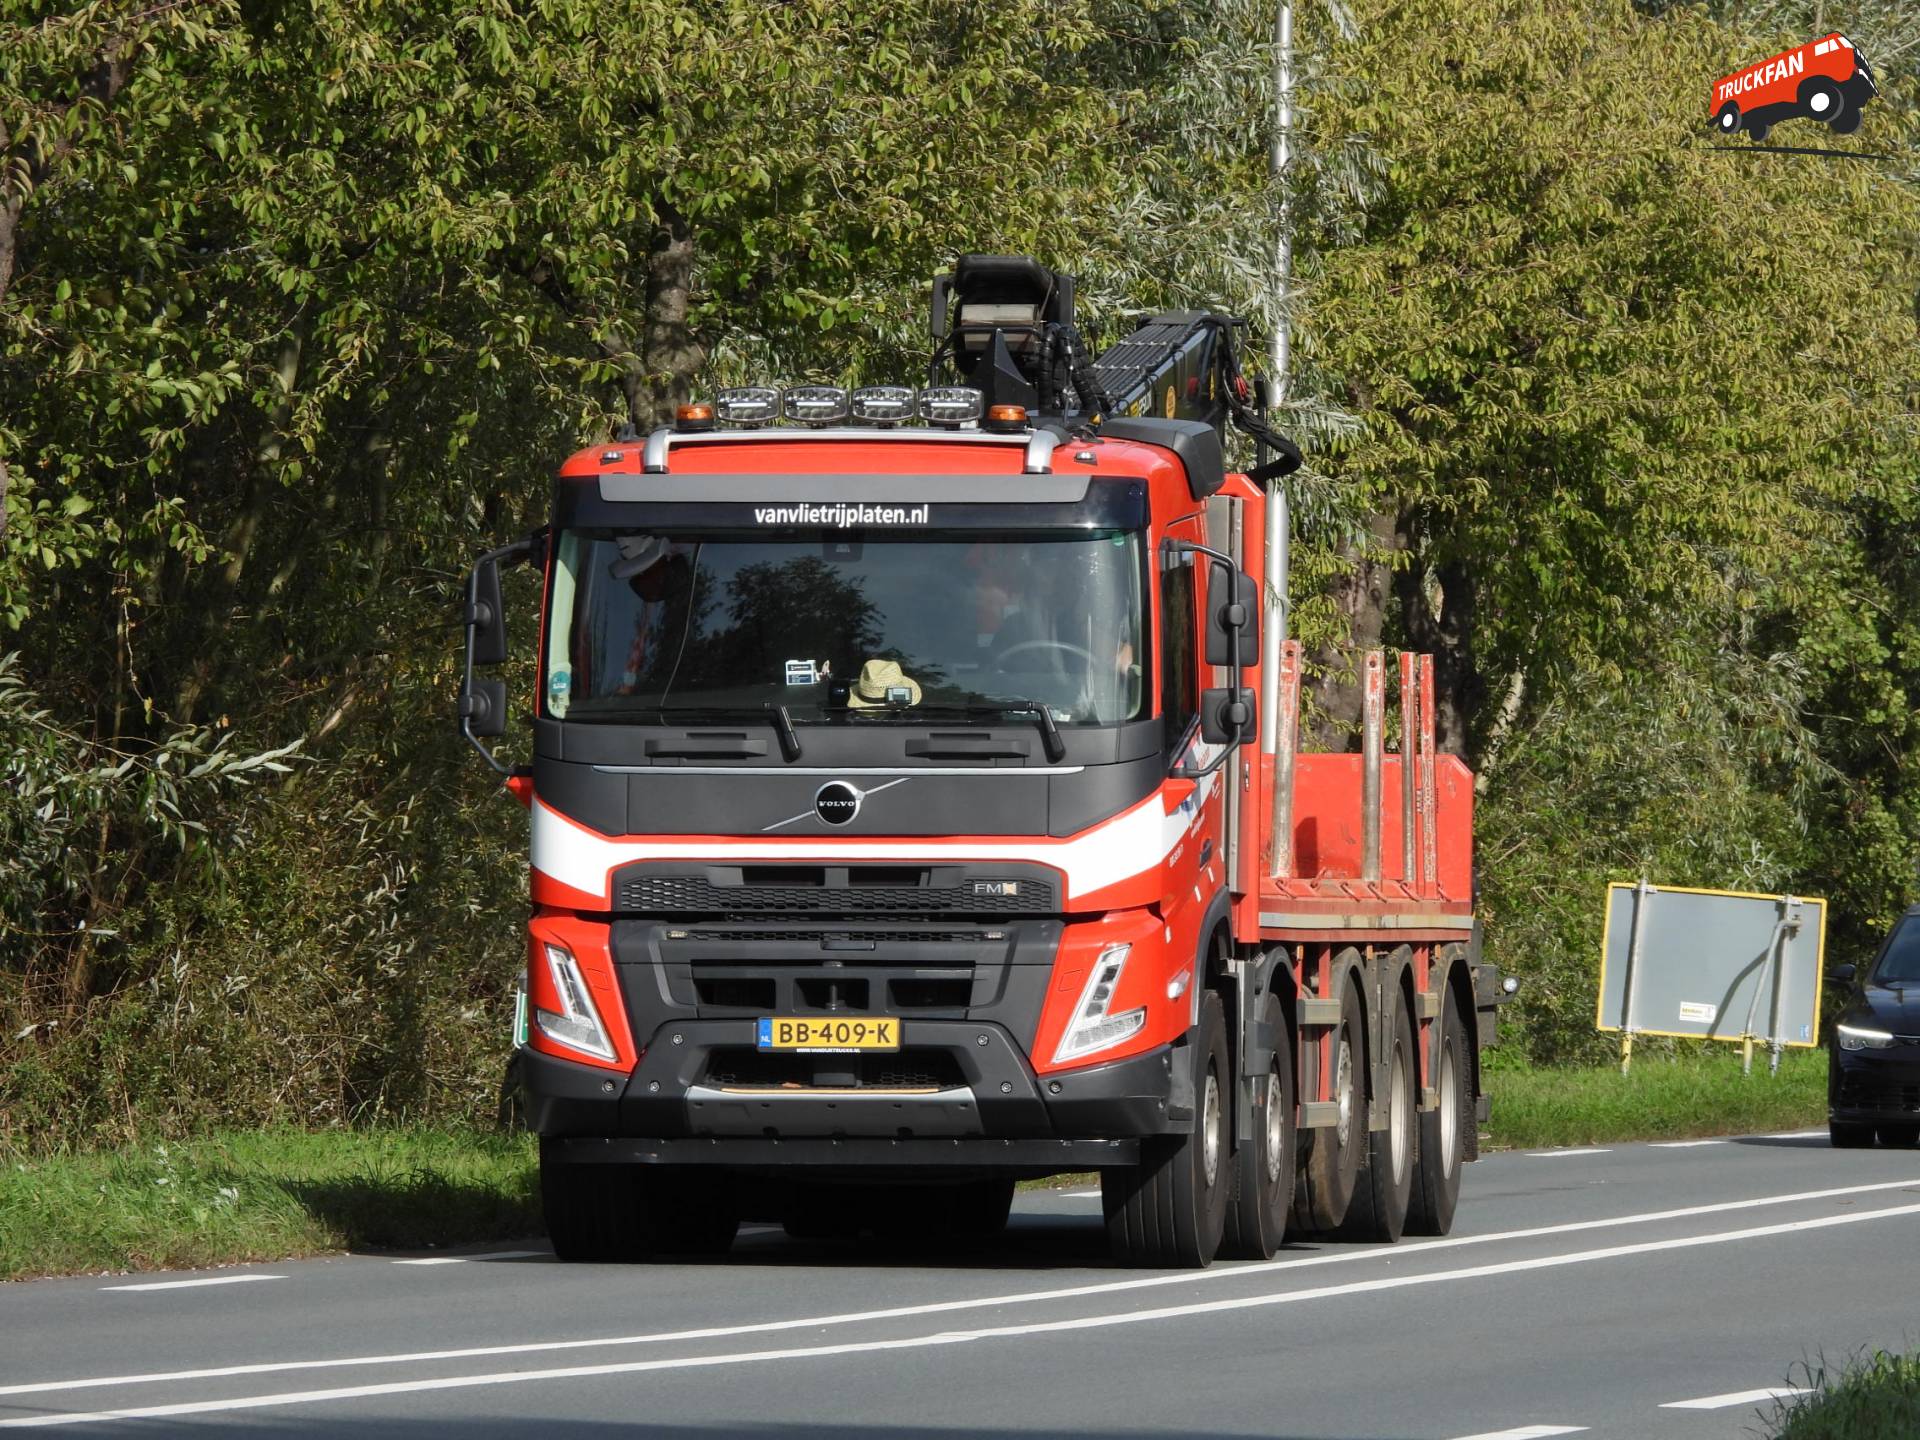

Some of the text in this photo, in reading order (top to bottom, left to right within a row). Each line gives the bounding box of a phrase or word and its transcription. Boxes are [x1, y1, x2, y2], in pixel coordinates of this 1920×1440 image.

[755, 503, 928, 528] vanvlietrijplaten.nl
[760, 1035, 771, 1043] NL
[779, 1022, 890, 1043] BB-409-K
